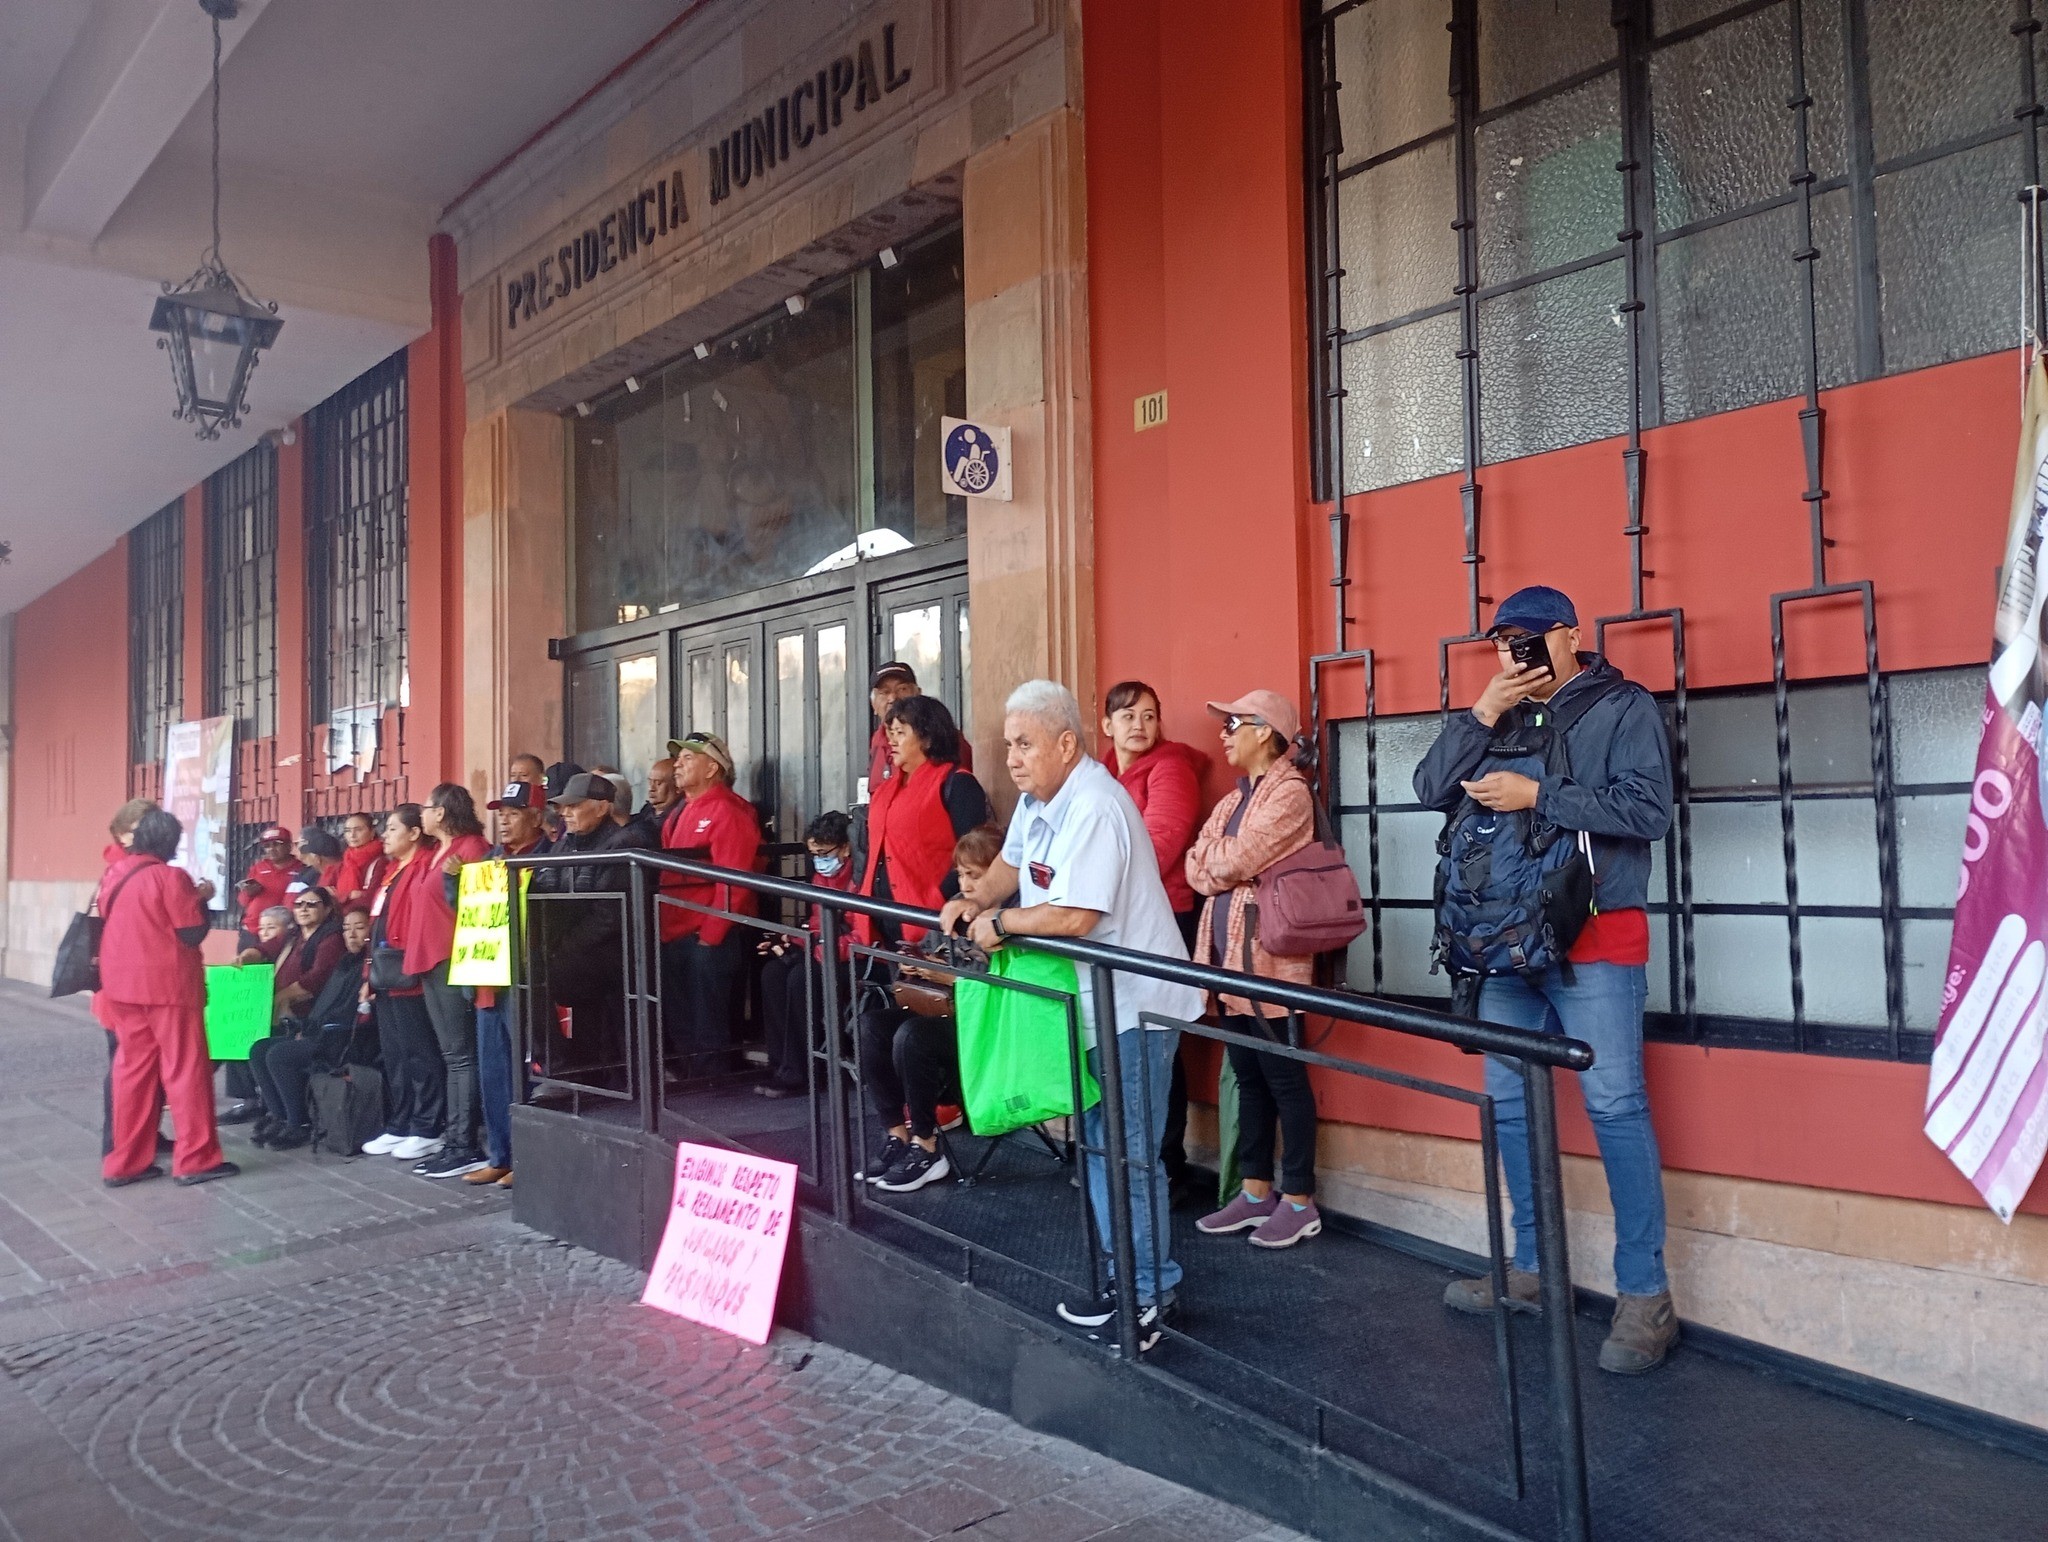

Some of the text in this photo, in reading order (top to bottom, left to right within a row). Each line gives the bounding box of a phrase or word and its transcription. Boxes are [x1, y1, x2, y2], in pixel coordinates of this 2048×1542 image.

[508, 21, 912, 329] PRESIDENCIA MUNICIPAL
[1142, 395, 1163, 424] 101
[764, 1210, 783, 1236] DE
